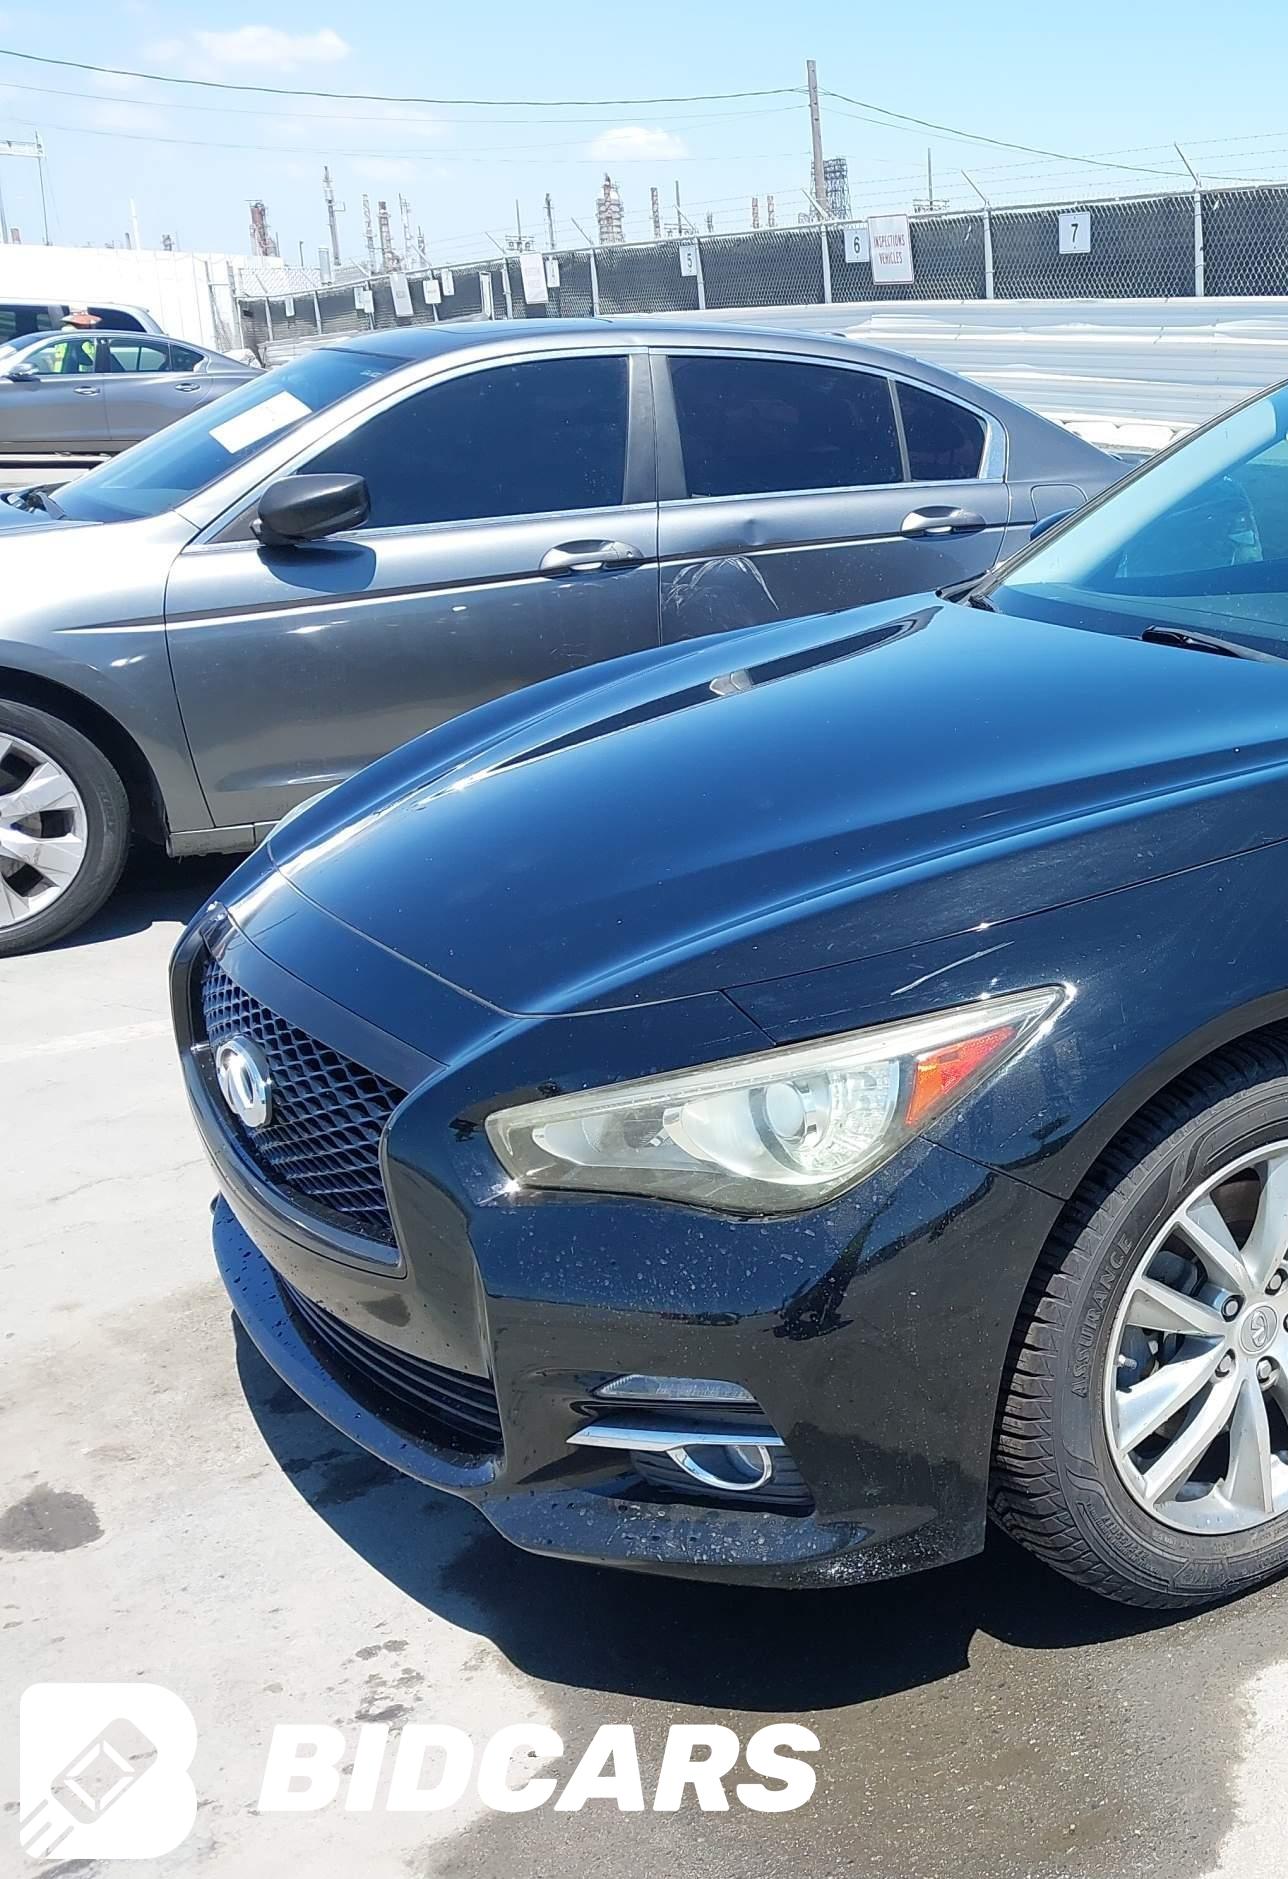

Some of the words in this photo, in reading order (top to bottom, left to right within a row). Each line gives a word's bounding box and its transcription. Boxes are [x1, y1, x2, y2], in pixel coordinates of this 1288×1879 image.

[1071, 223, 1079, 243] 7
[853, 236, 861, 254] 6
[687, 252, 693, 269] 5
[879, 251, 903, 265] VEHICLES
[1071, 1232, 1133, 1399] ASSURANCE
